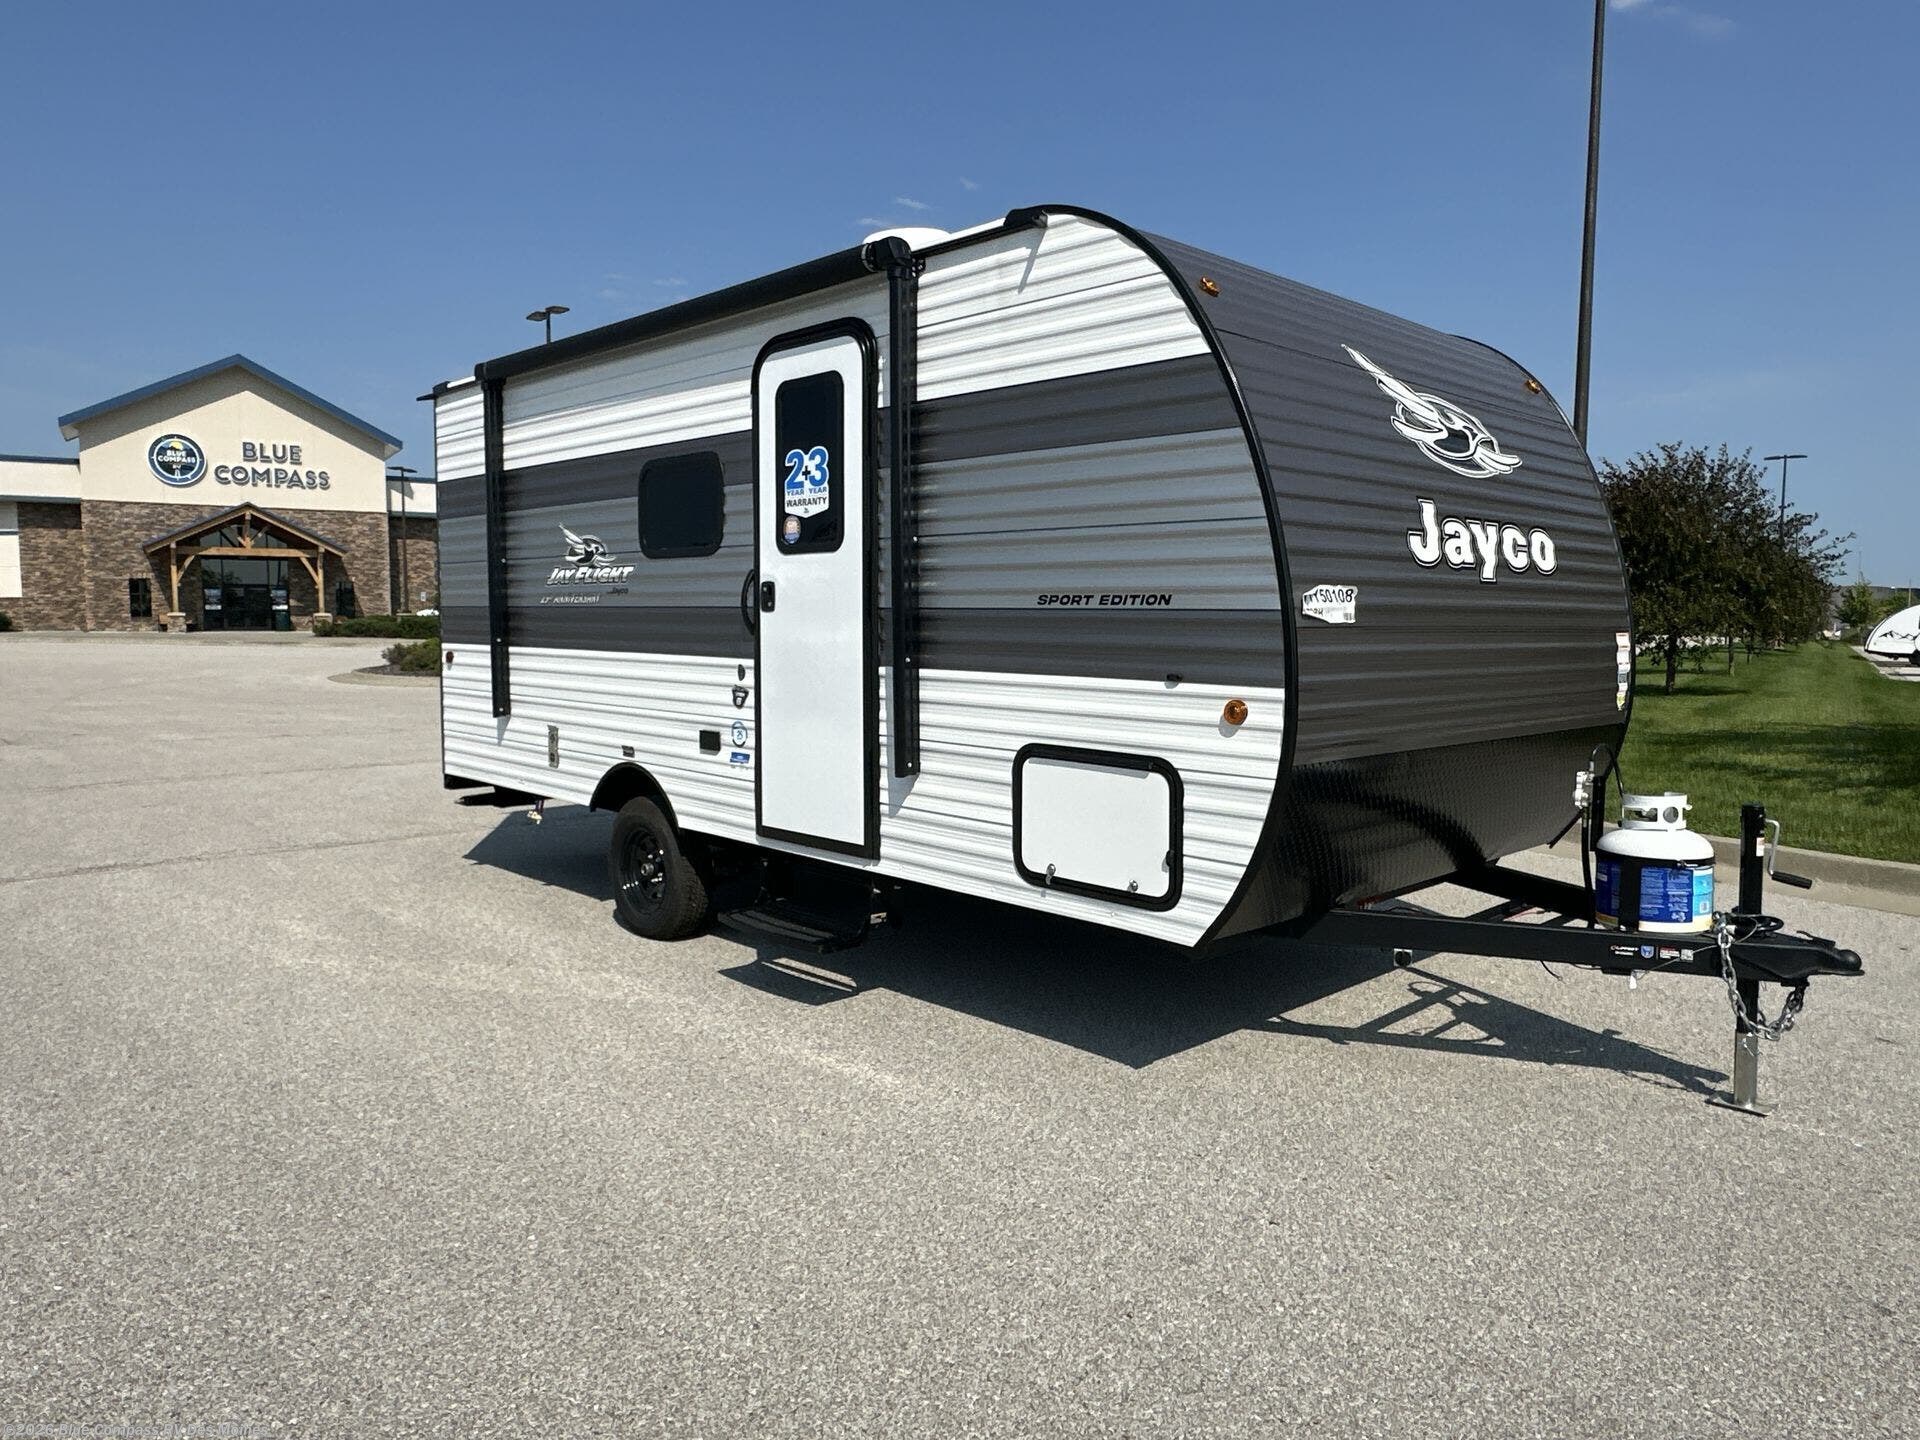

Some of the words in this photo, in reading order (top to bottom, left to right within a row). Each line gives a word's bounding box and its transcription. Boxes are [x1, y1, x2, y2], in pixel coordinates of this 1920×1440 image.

[157, 455, 196, 463] COMPASS
[242, 442, 302, 465] BLUE
[214, 465, 331, 489] COMPASS
[808, 486, 828, 494] YEAR
[786, 497, 828, 508] WARRANTY
[1407, 496, 1558, 583] Jayco
[545, 566, 576, 586] JAY
[574, 565, 636, 585] FLIGHT
[1037, 594, 1094, 606] SPORT
[1098, 594, 1172, 606] EDITION
